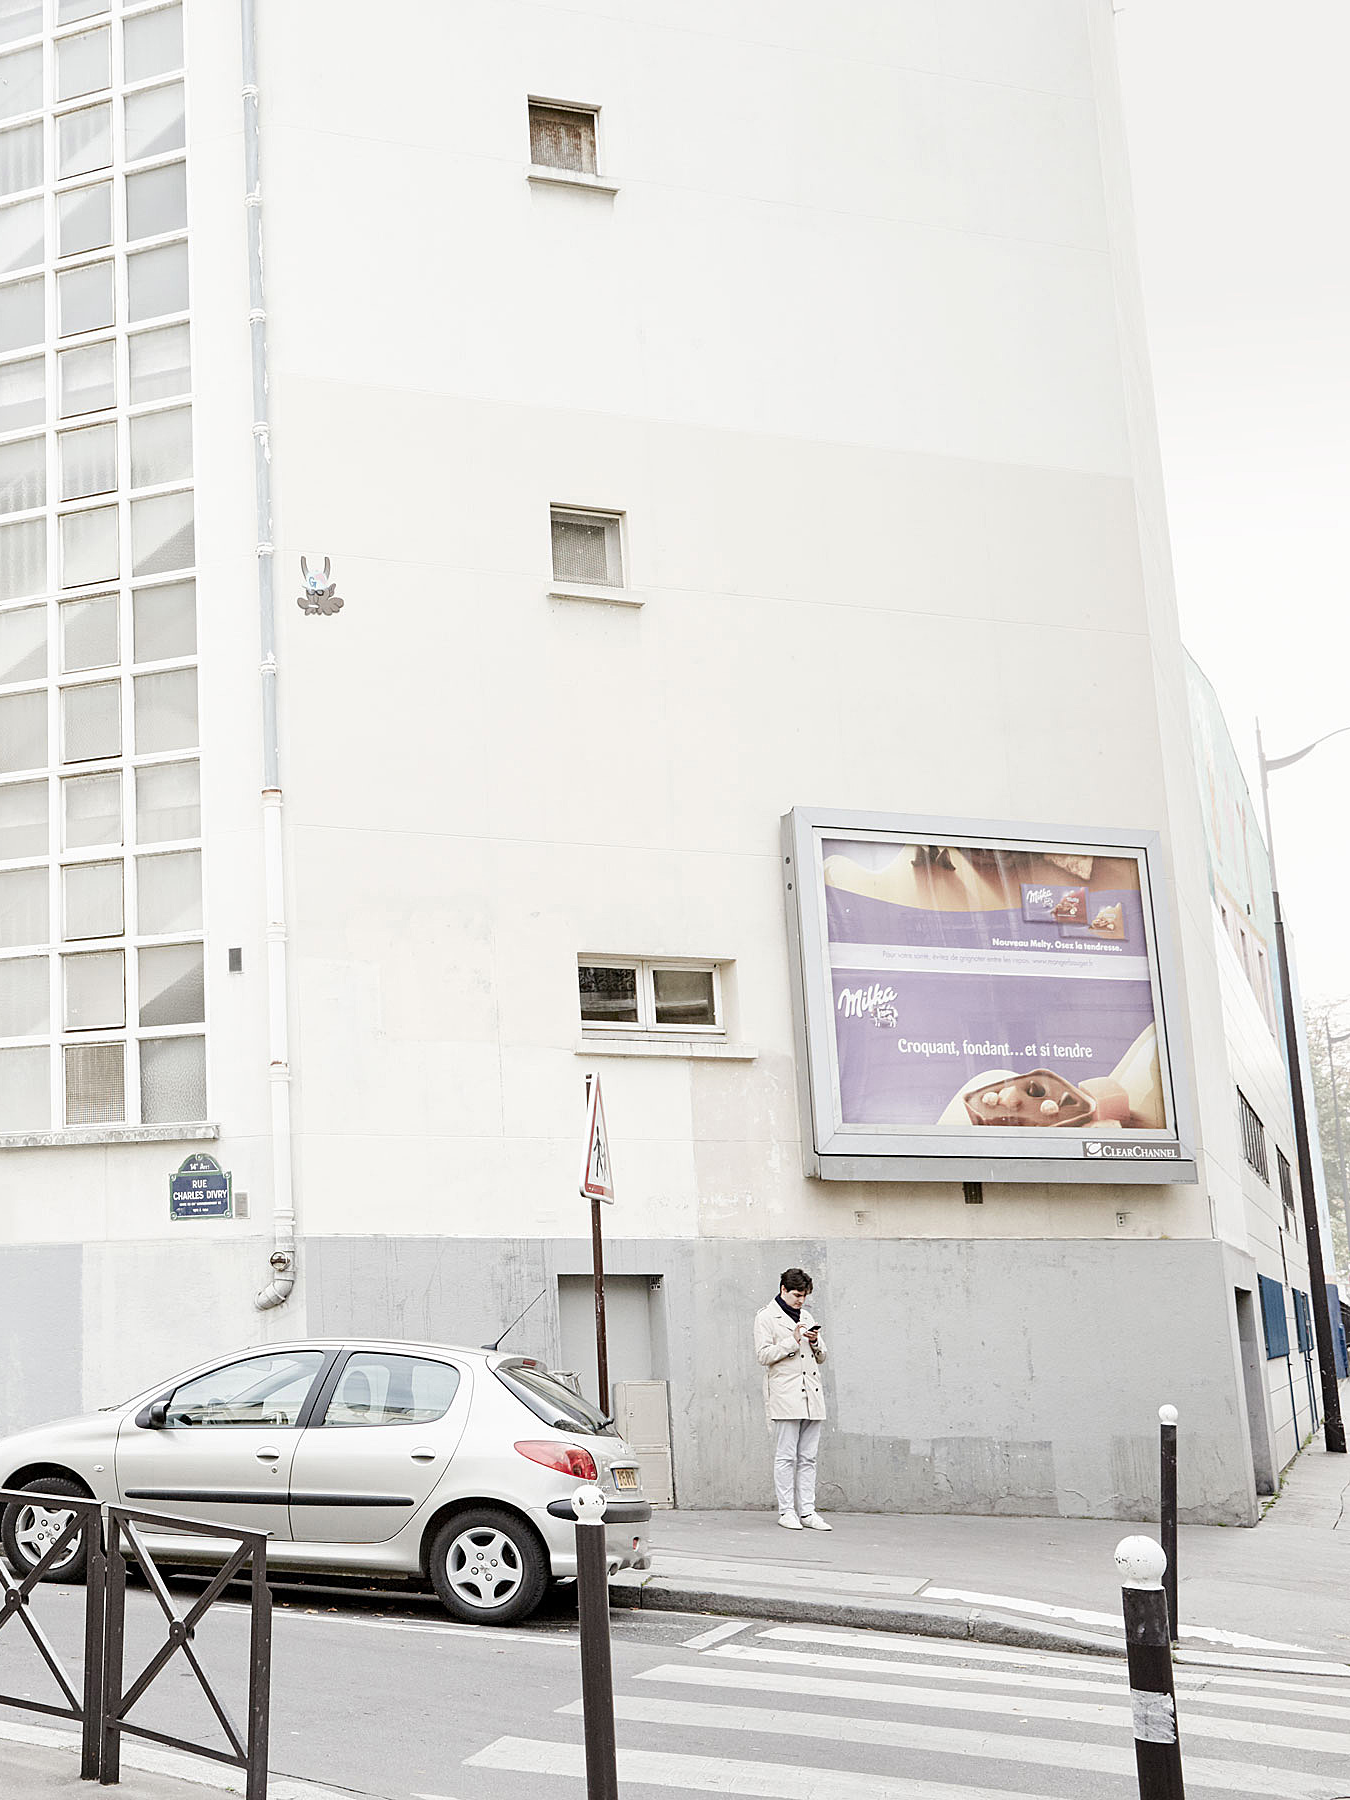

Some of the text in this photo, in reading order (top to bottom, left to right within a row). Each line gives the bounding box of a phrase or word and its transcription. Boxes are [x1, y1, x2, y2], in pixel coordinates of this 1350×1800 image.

[1026, 888, 1052, 904] Milka
[992, 938, 1123, 952] Nouveau Melty. Osez la tendresse.
[837, 983, 898, 1018] Milka
[897, 1038, 960, 1057] Croquant,
[1040, 1042, 1050, 1057] si
[1053, 1043, 1093, 1058] tendre
[192, 1179, 208, 1188] RUE
[173, 1190, 227, 1201] CHARLES DIVRY
